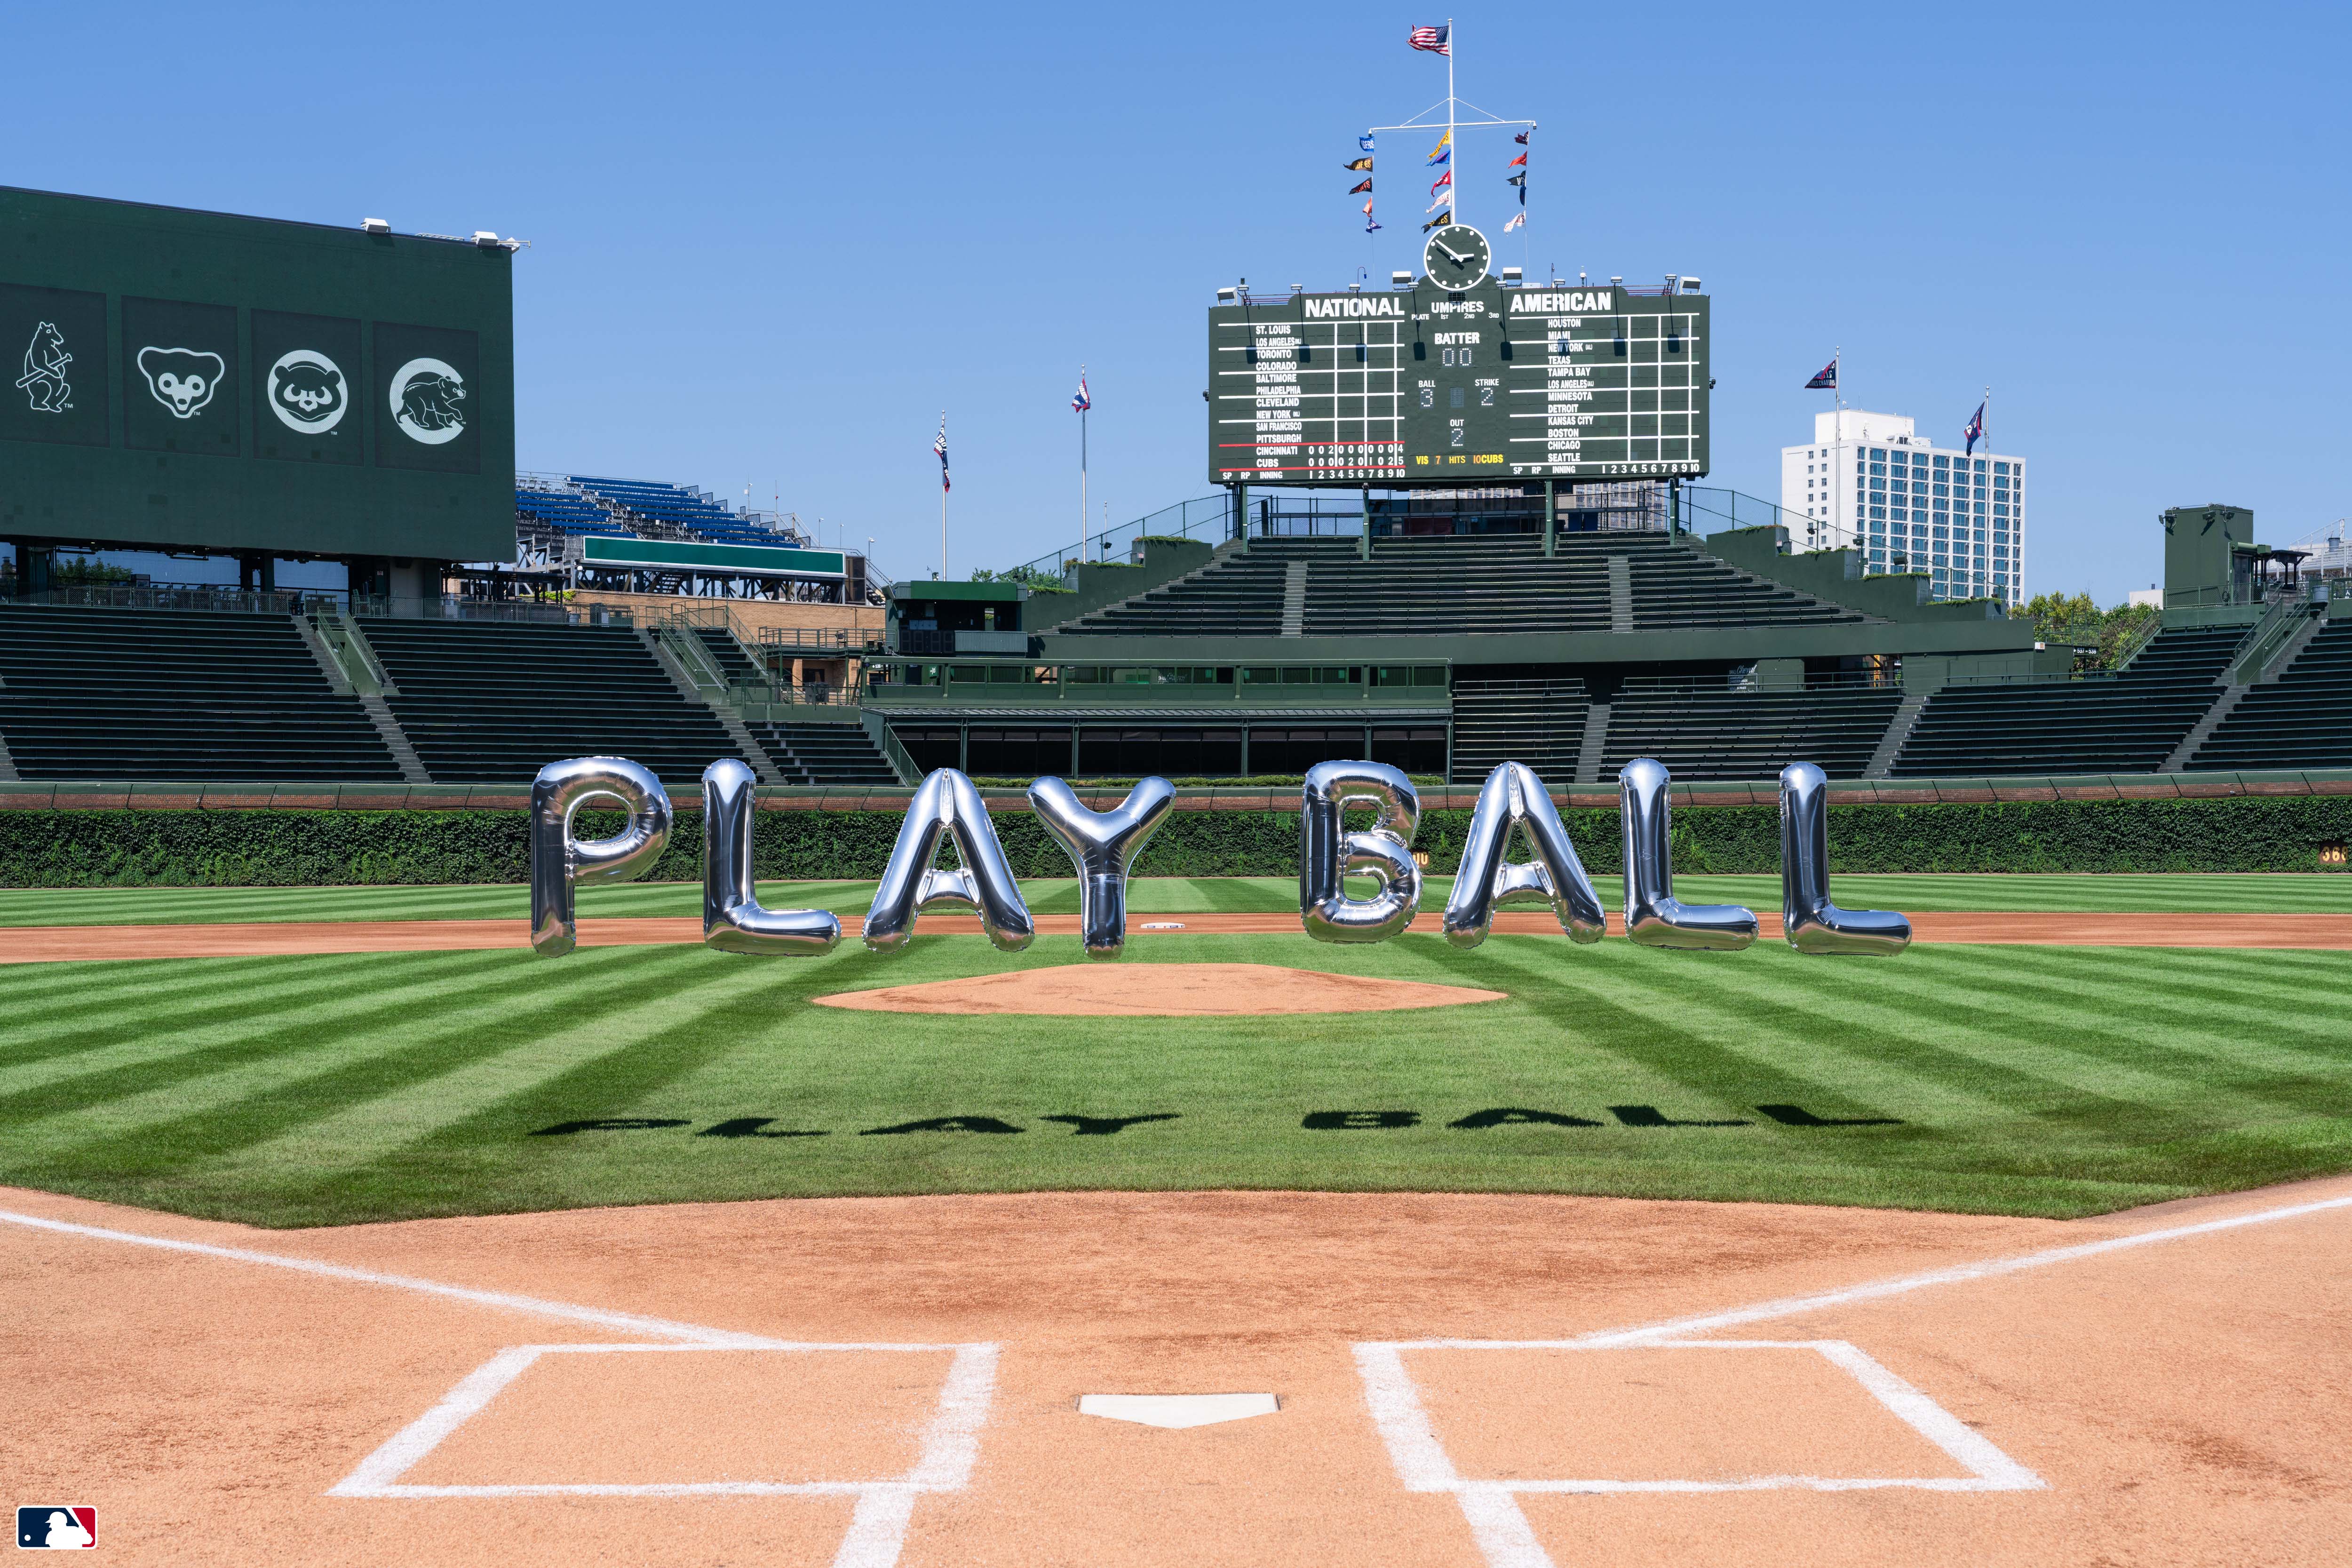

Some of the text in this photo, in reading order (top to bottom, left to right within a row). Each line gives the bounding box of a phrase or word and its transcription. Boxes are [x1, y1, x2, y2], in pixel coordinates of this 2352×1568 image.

[1431, 301, 1484, 313] UMPIRES
[1510, 293, 1611, 312] AMERICAN
[1306, 298, 1405, 317] NATIONAL
[1548, 318, 1581, 327] HOUSTON
[1256, 325, 1290, 334] ST. LOUIS
[1435, 332, 1479, 344] BATTER
[1548, 331, 1570, 340] MIAMI
[1256, 338, 1267, 346] LOS
[1269, 337, 1295, 346] ANGELES
[1548, 344, 1563, 352] NEW
[1565, 343, 1583, 352] YORK
[1256, 350, 1292, 358] TORONTO
[1548, 356, 1570, 364] TEXAS
[1256, 362, 1297, 371] COLORADO
[1548, 367, 1590, 376] TAMPA BAY
[1256, 374, 1296, 382] BALTIMORE
[1548, 380, 1559, 389] LOS
[1561, 380, 1587, 389] ANGELES
[1256, 386, 1301, 395] PHILADELPHIA
[1422, 389, 1432, 406] 3
[1482, 388, 1493, 406] 2
[1548, 392, 1592, 401] MINNESOTA
[1256, 398, 1299, 407] CLEVELAND
[1548, 404, 1578, 413] DETROIT
[1272, 410, 1291, 419] YORK
[1549, 416, 1593, 425] KANSAS CITY
[1256, 422, 1302, 431] SAN FRANCISCO
[1452, 429, 1463, 446] 2
[1548, 429, 1579, 438] BOSTON
[1257, 434, 1301, 443] PITTSBURGH
[1256, 446, 1297, 455] CINCINNATI
[1309, 446, 1314, 454] 0
[1348, 445, 1353, 454] 0
[1358, 445, 1363, 454] 0
[1378, 445, 1383, 453] 0
[1398, 444, 1403, 453] 4
[1548, 441, 1580, 450] CHICAGO
[1256, 459, 1278, 467] CUBS
[1319, 458, 1324, 466] 0
[1338, 457, 1343, 466] 0
[1378, 457, 1383, 465] 0
[1398, 456, 1403, 465] 5
[1416, 456, 1429, 464] VIS
[1474, 455, 1481, 463] 10
[1481, 454, 1503, 463] CUBS
[1548, 453, 1580, 462] SEATTLE
[1621, 465, 1627, 473] 3
[1642, 464, 1647, 473] 5
[1651, 464, 1657, 473] 6
[1672, 464, 1677, 472] 8
[1691, 463, 1699, 472] 10
[1338, 470, 1343, 478] 4
[1358, 470, 1364, 478] 6
[1388, 469, 1393, 478] 9
[1397, 469, 1405, 478] 10
[530, 756, 1913, 960] PLAY BALL
